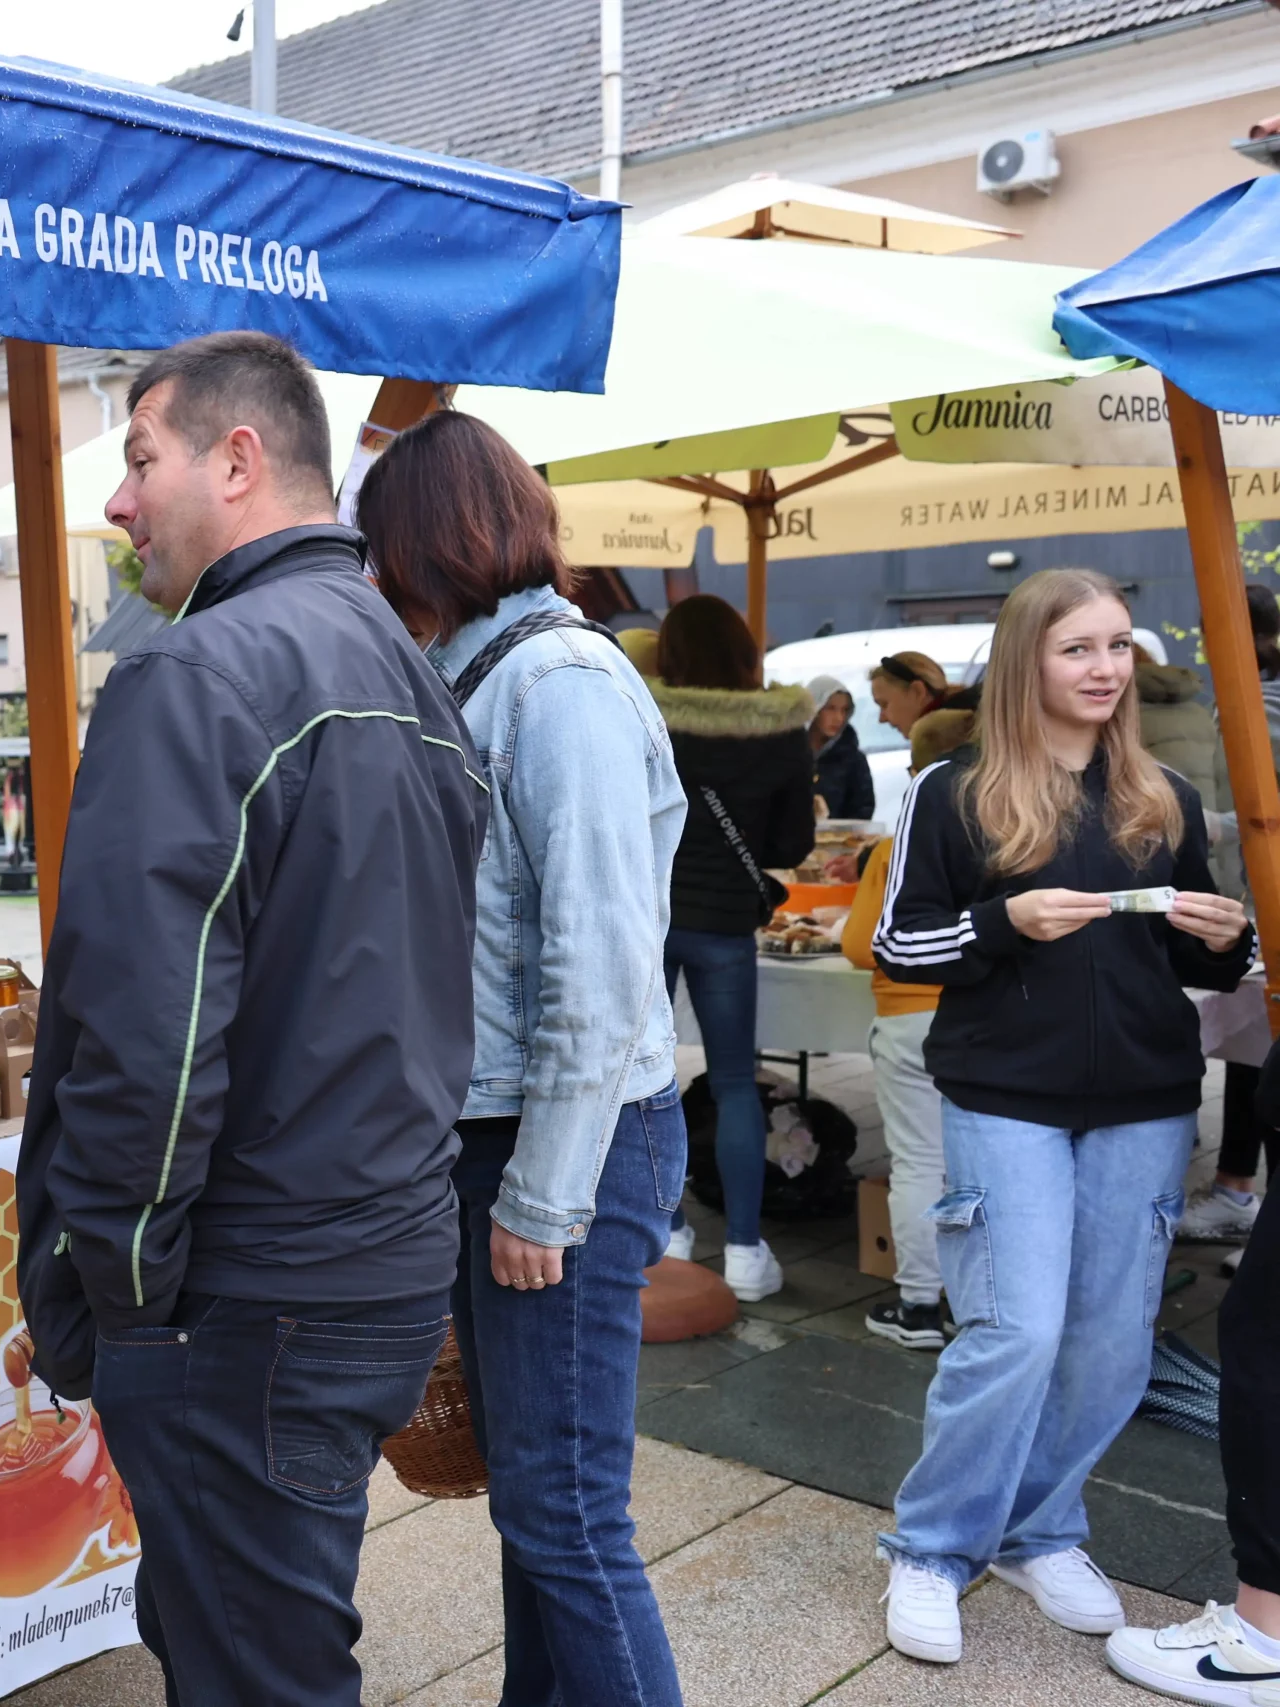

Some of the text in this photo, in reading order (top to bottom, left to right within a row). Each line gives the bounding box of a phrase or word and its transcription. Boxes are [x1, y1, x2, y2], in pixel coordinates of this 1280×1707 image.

[33, 202, 165, 279] GRADA
[174, 223, 329, 302] PRELOGA
[912, 390, 1053, 436] Jamnica
